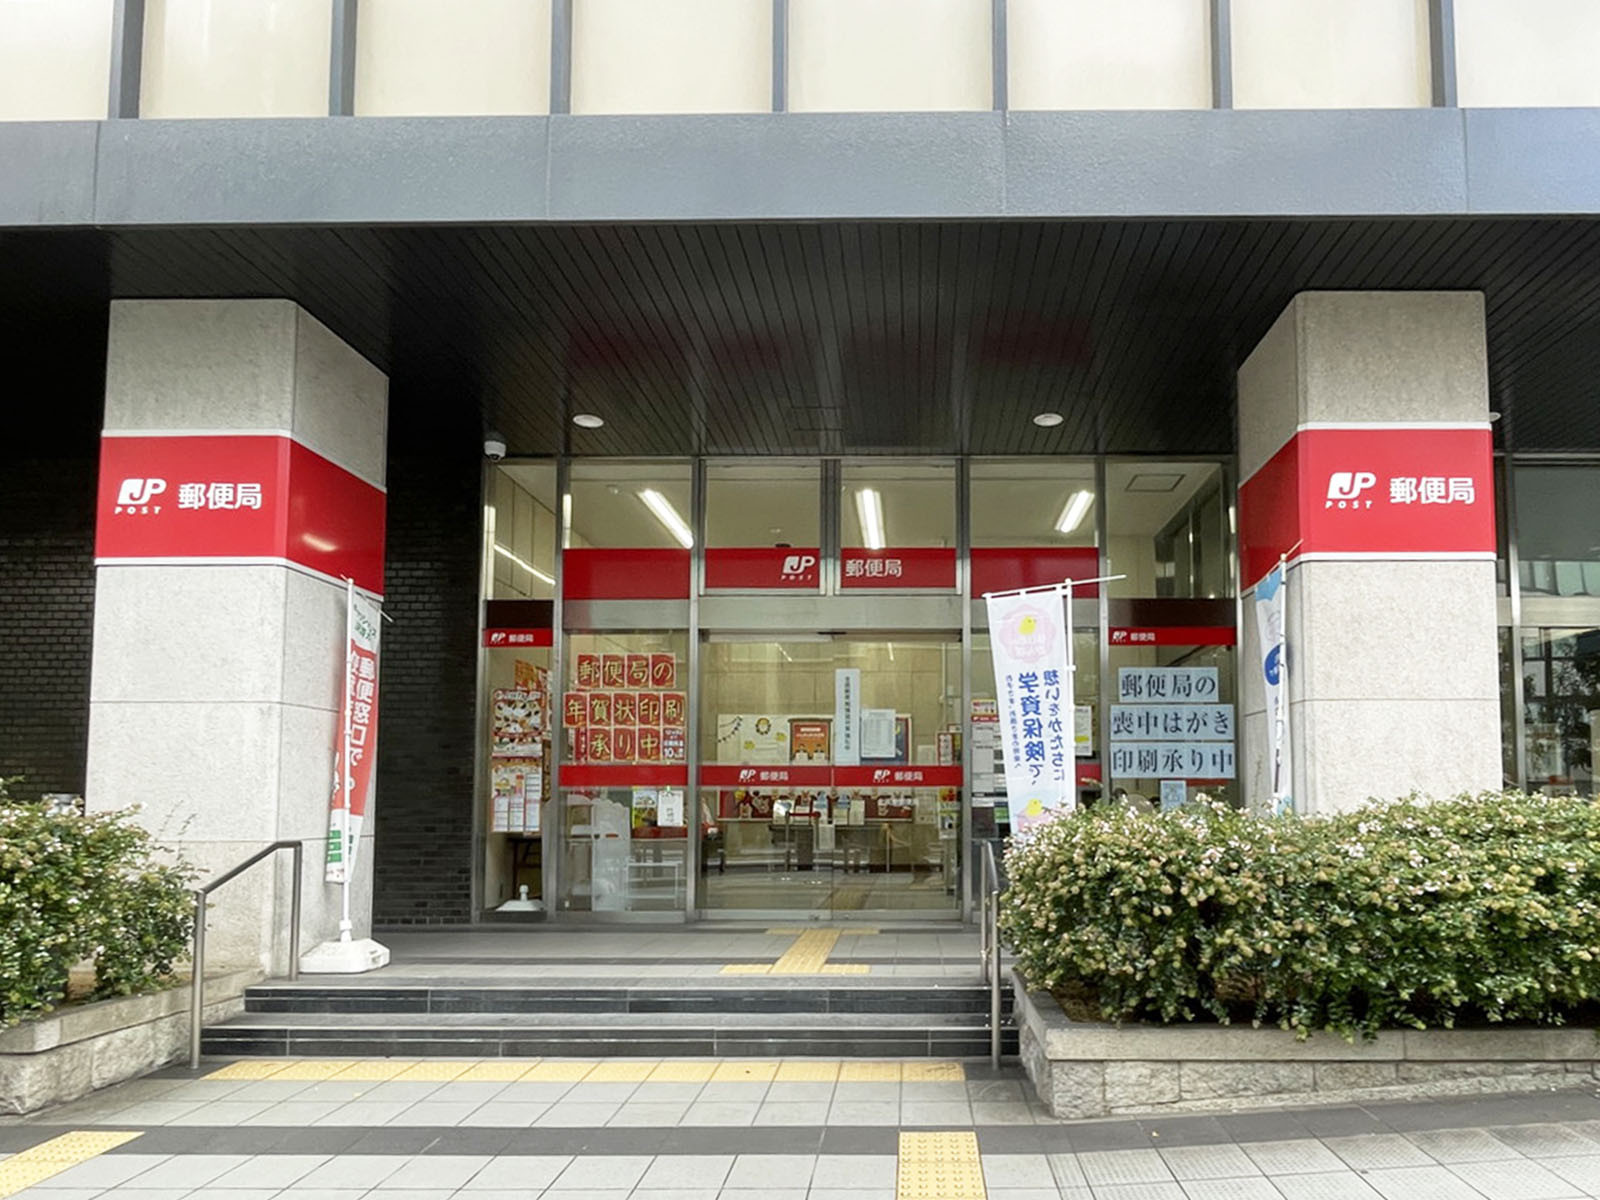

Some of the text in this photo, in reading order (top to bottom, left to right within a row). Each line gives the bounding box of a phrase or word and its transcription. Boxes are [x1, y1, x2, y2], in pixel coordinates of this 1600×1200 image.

[117, 478, 167, 505] JP
[178, 482, 262, 510] 郵便局
[1327, 472, 1377, 499] JP
[1389, 476, 1475, 504] 郵便局
[114, 506, 162, 515] POST
[1325, 500, 1373, 509] POST
[782, 556, 816, 574] JP
[845, 558, 902, 577] 郵便局
[579, 660, 673, 683] 郵便局の
[1121, 674, 1216, 697] 郵便局の
[567, 698, 685, 722] 年賀状印刷
[1113, 711, 1229, 735] 喪中はがき
[590, 733, 660, 758] 承り中
[1113, 748, 1232, 773] 印刷承り中
